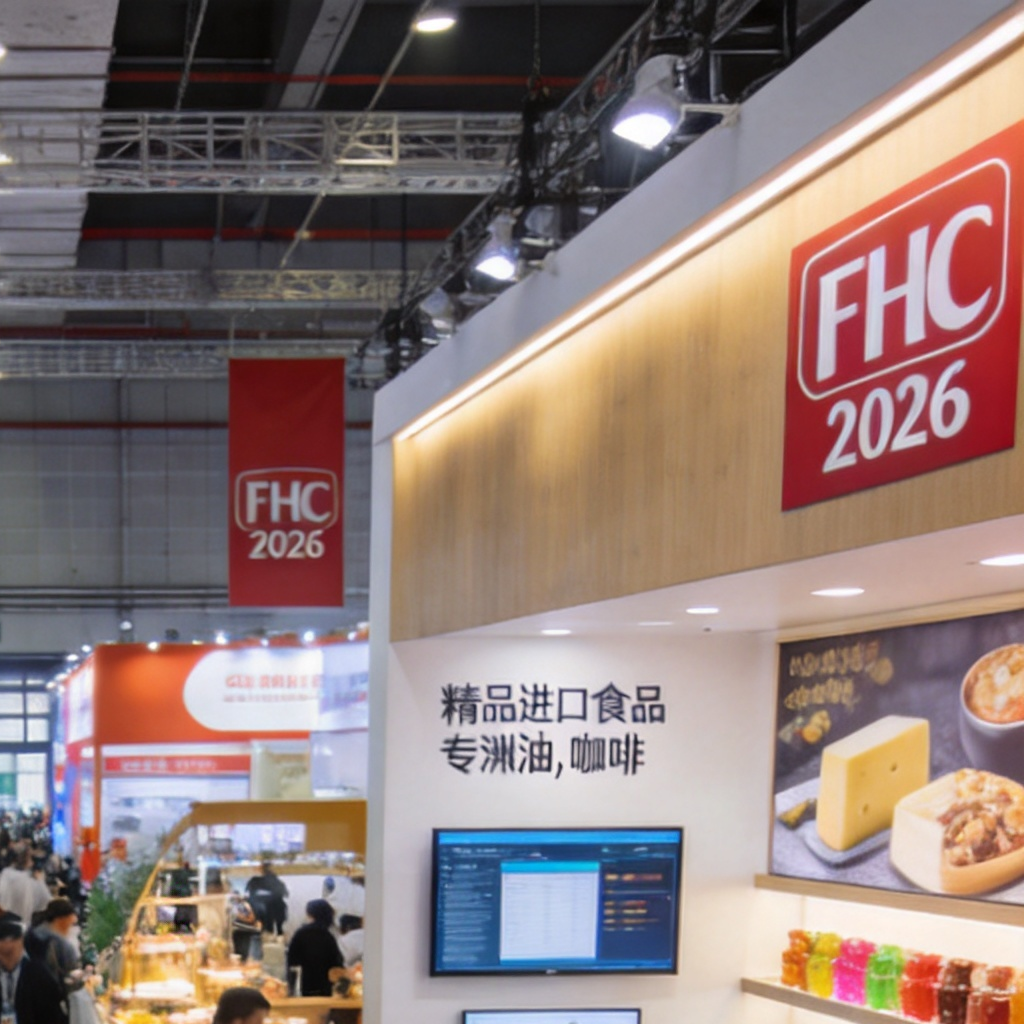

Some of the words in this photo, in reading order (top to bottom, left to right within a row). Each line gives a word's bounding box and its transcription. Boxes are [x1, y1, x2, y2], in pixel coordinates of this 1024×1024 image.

[817, 204, 993, 382] FHC
[822, 360, 971, 473] 2026
[245, 480, 331, 524] FHC
[248, 529, 326, 560] 2026
[440, 682, 666, 726] 精品进口食品
